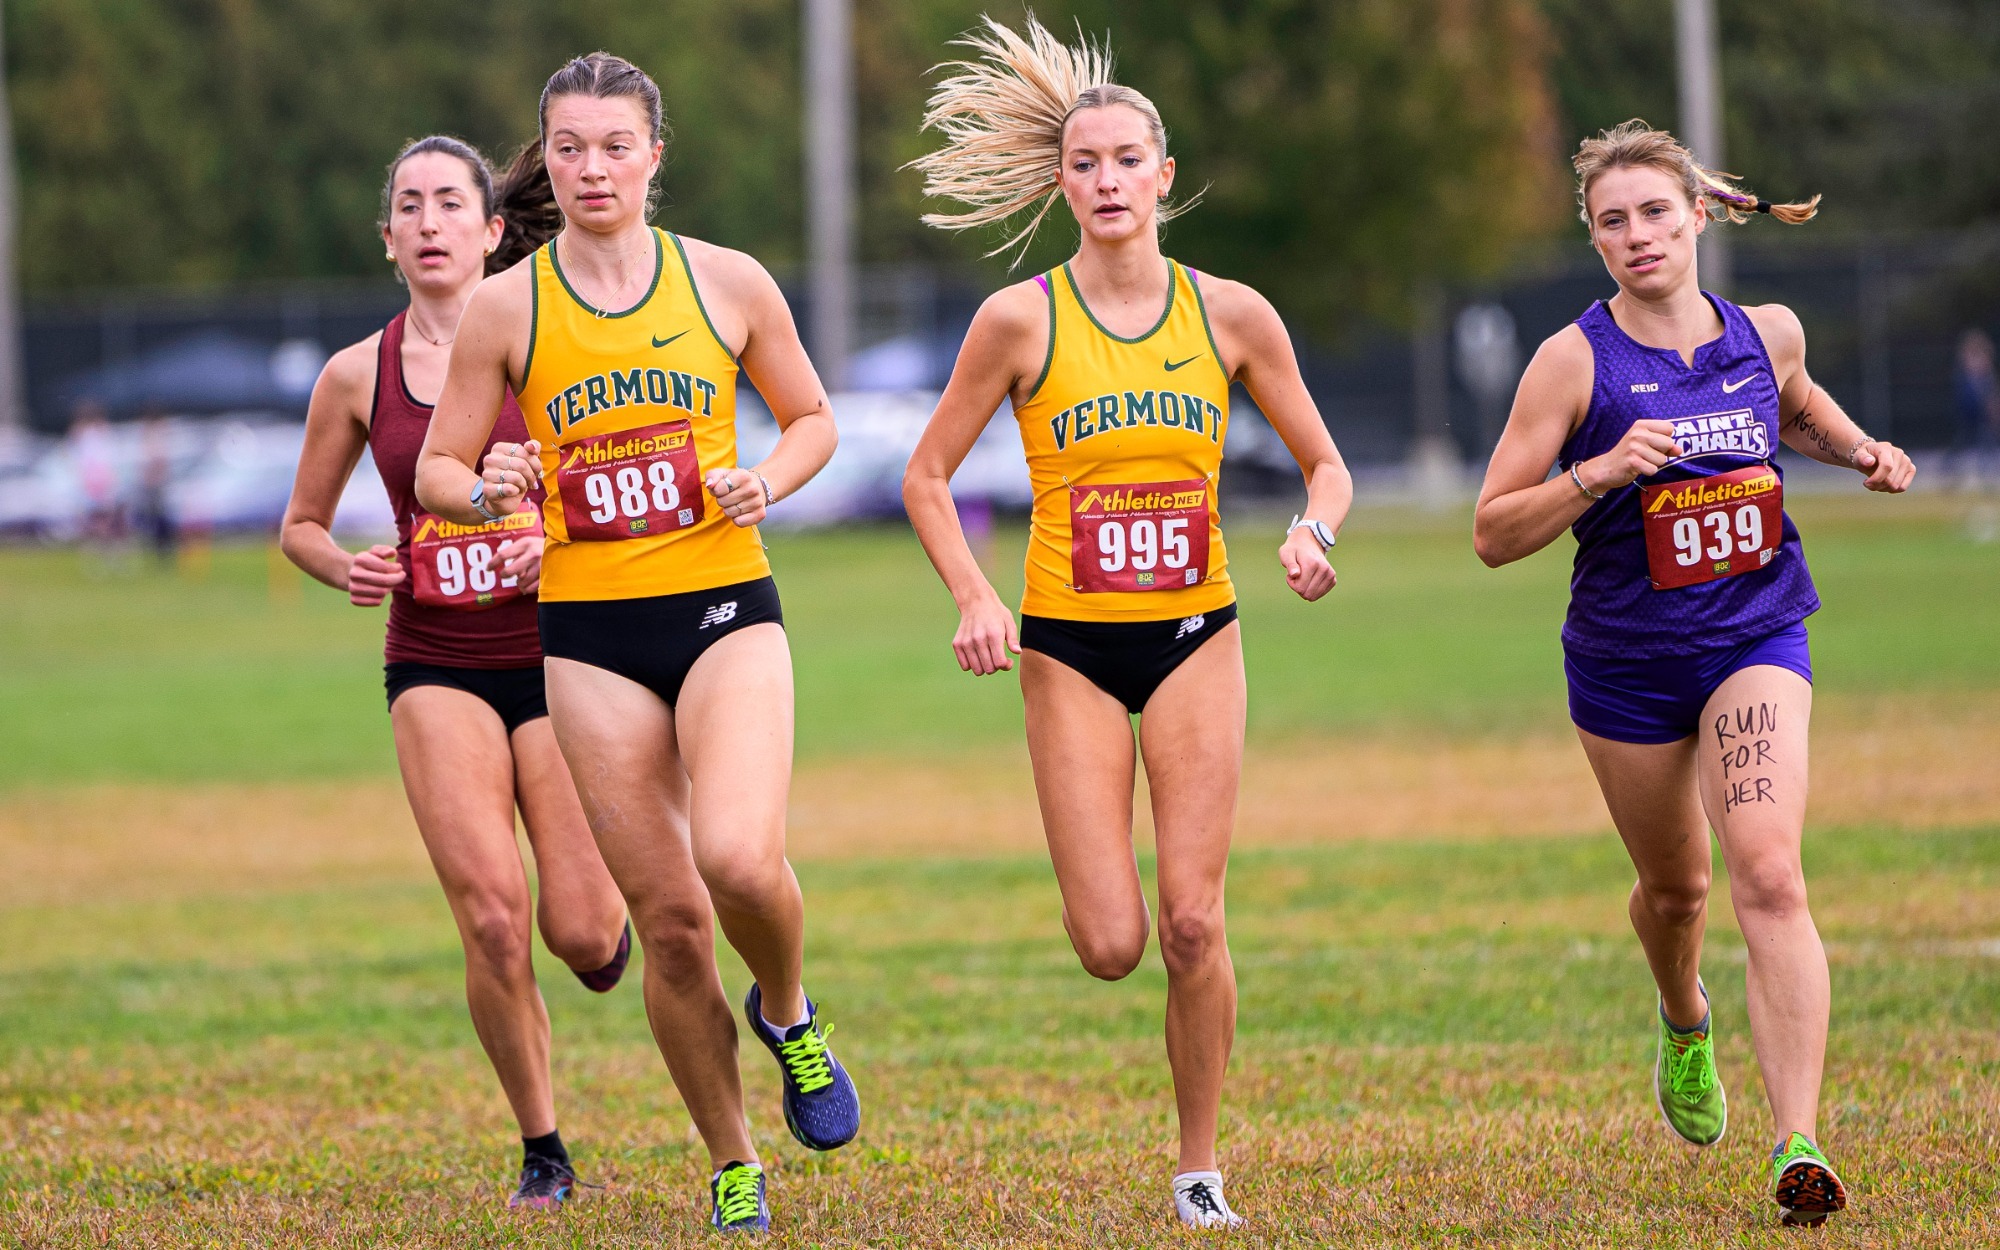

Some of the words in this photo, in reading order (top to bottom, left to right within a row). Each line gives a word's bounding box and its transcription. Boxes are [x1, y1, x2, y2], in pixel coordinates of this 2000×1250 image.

[546, 367, 716, 437] VERMONT
[1050, 390, 1221, 452] VERMONT
[1671, 412, 1750, 437] AINT
[584, 460, 681, 525] 988
[1098, 518, 1190, 572] 995
[1673, 505, 1763, 567] 939
[1714, 702, 1777, 750] RUN
[1721, 740, 1777, 780] FOR
[1724, 777, 1776, 814] HER
